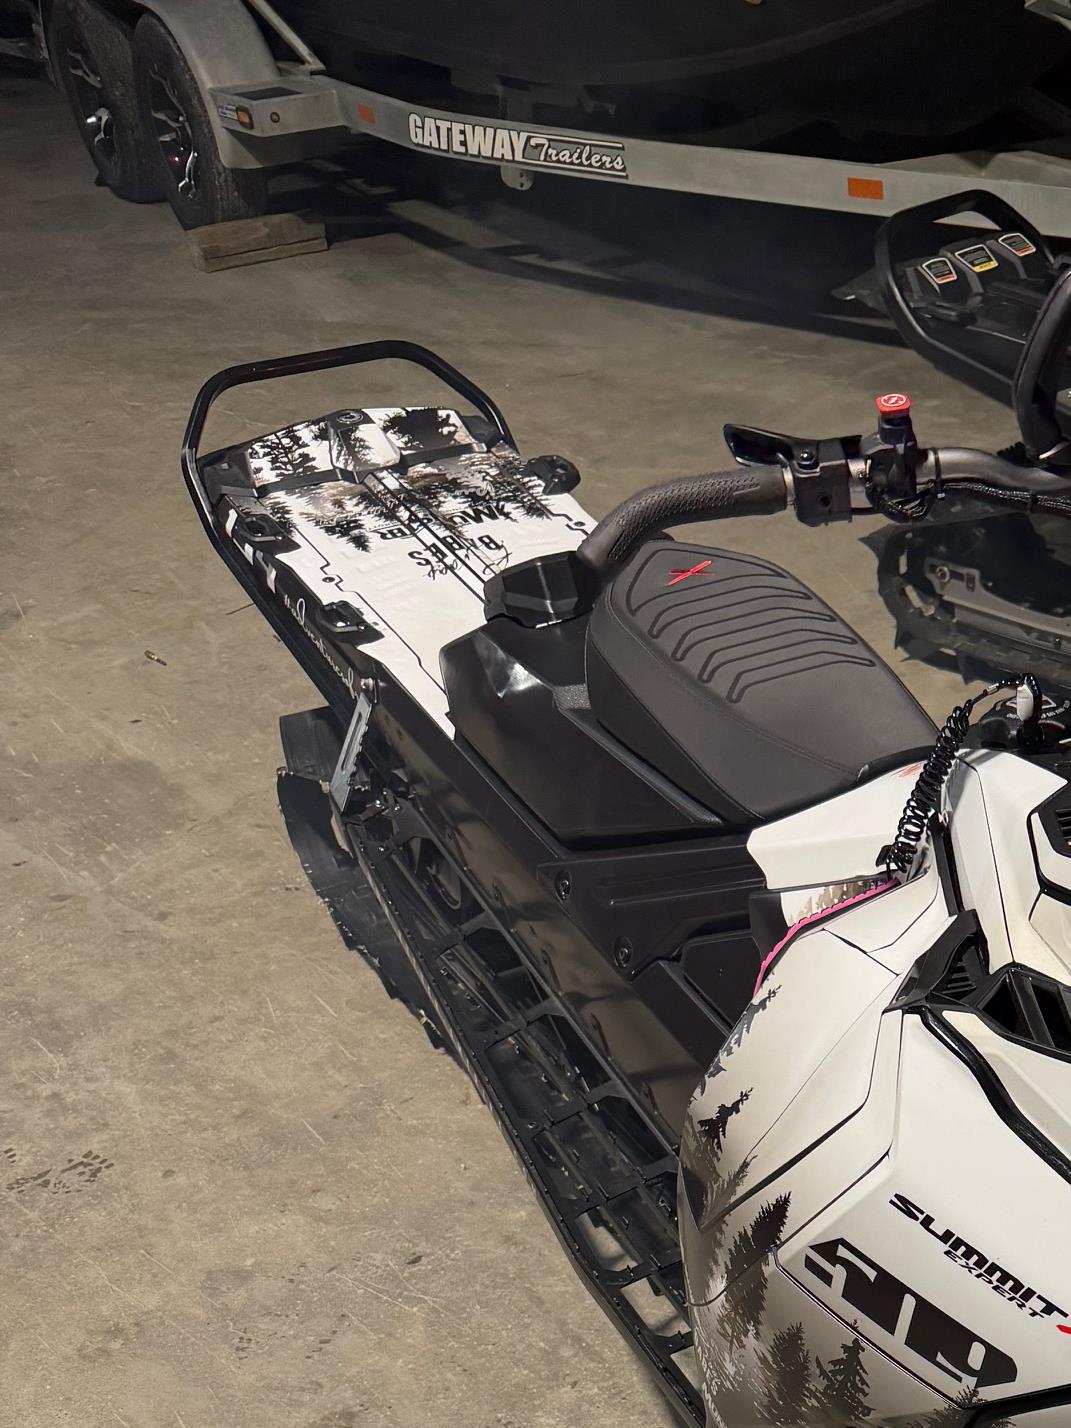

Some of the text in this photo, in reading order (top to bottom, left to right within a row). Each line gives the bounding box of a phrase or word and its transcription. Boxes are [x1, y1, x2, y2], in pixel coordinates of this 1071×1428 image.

[408, 112, 624, 169] GATEWAY Trailers
[889, 1193, 1069, 1318] SUMMIT
[943, 1249, 1045, 1318] EXPERT
